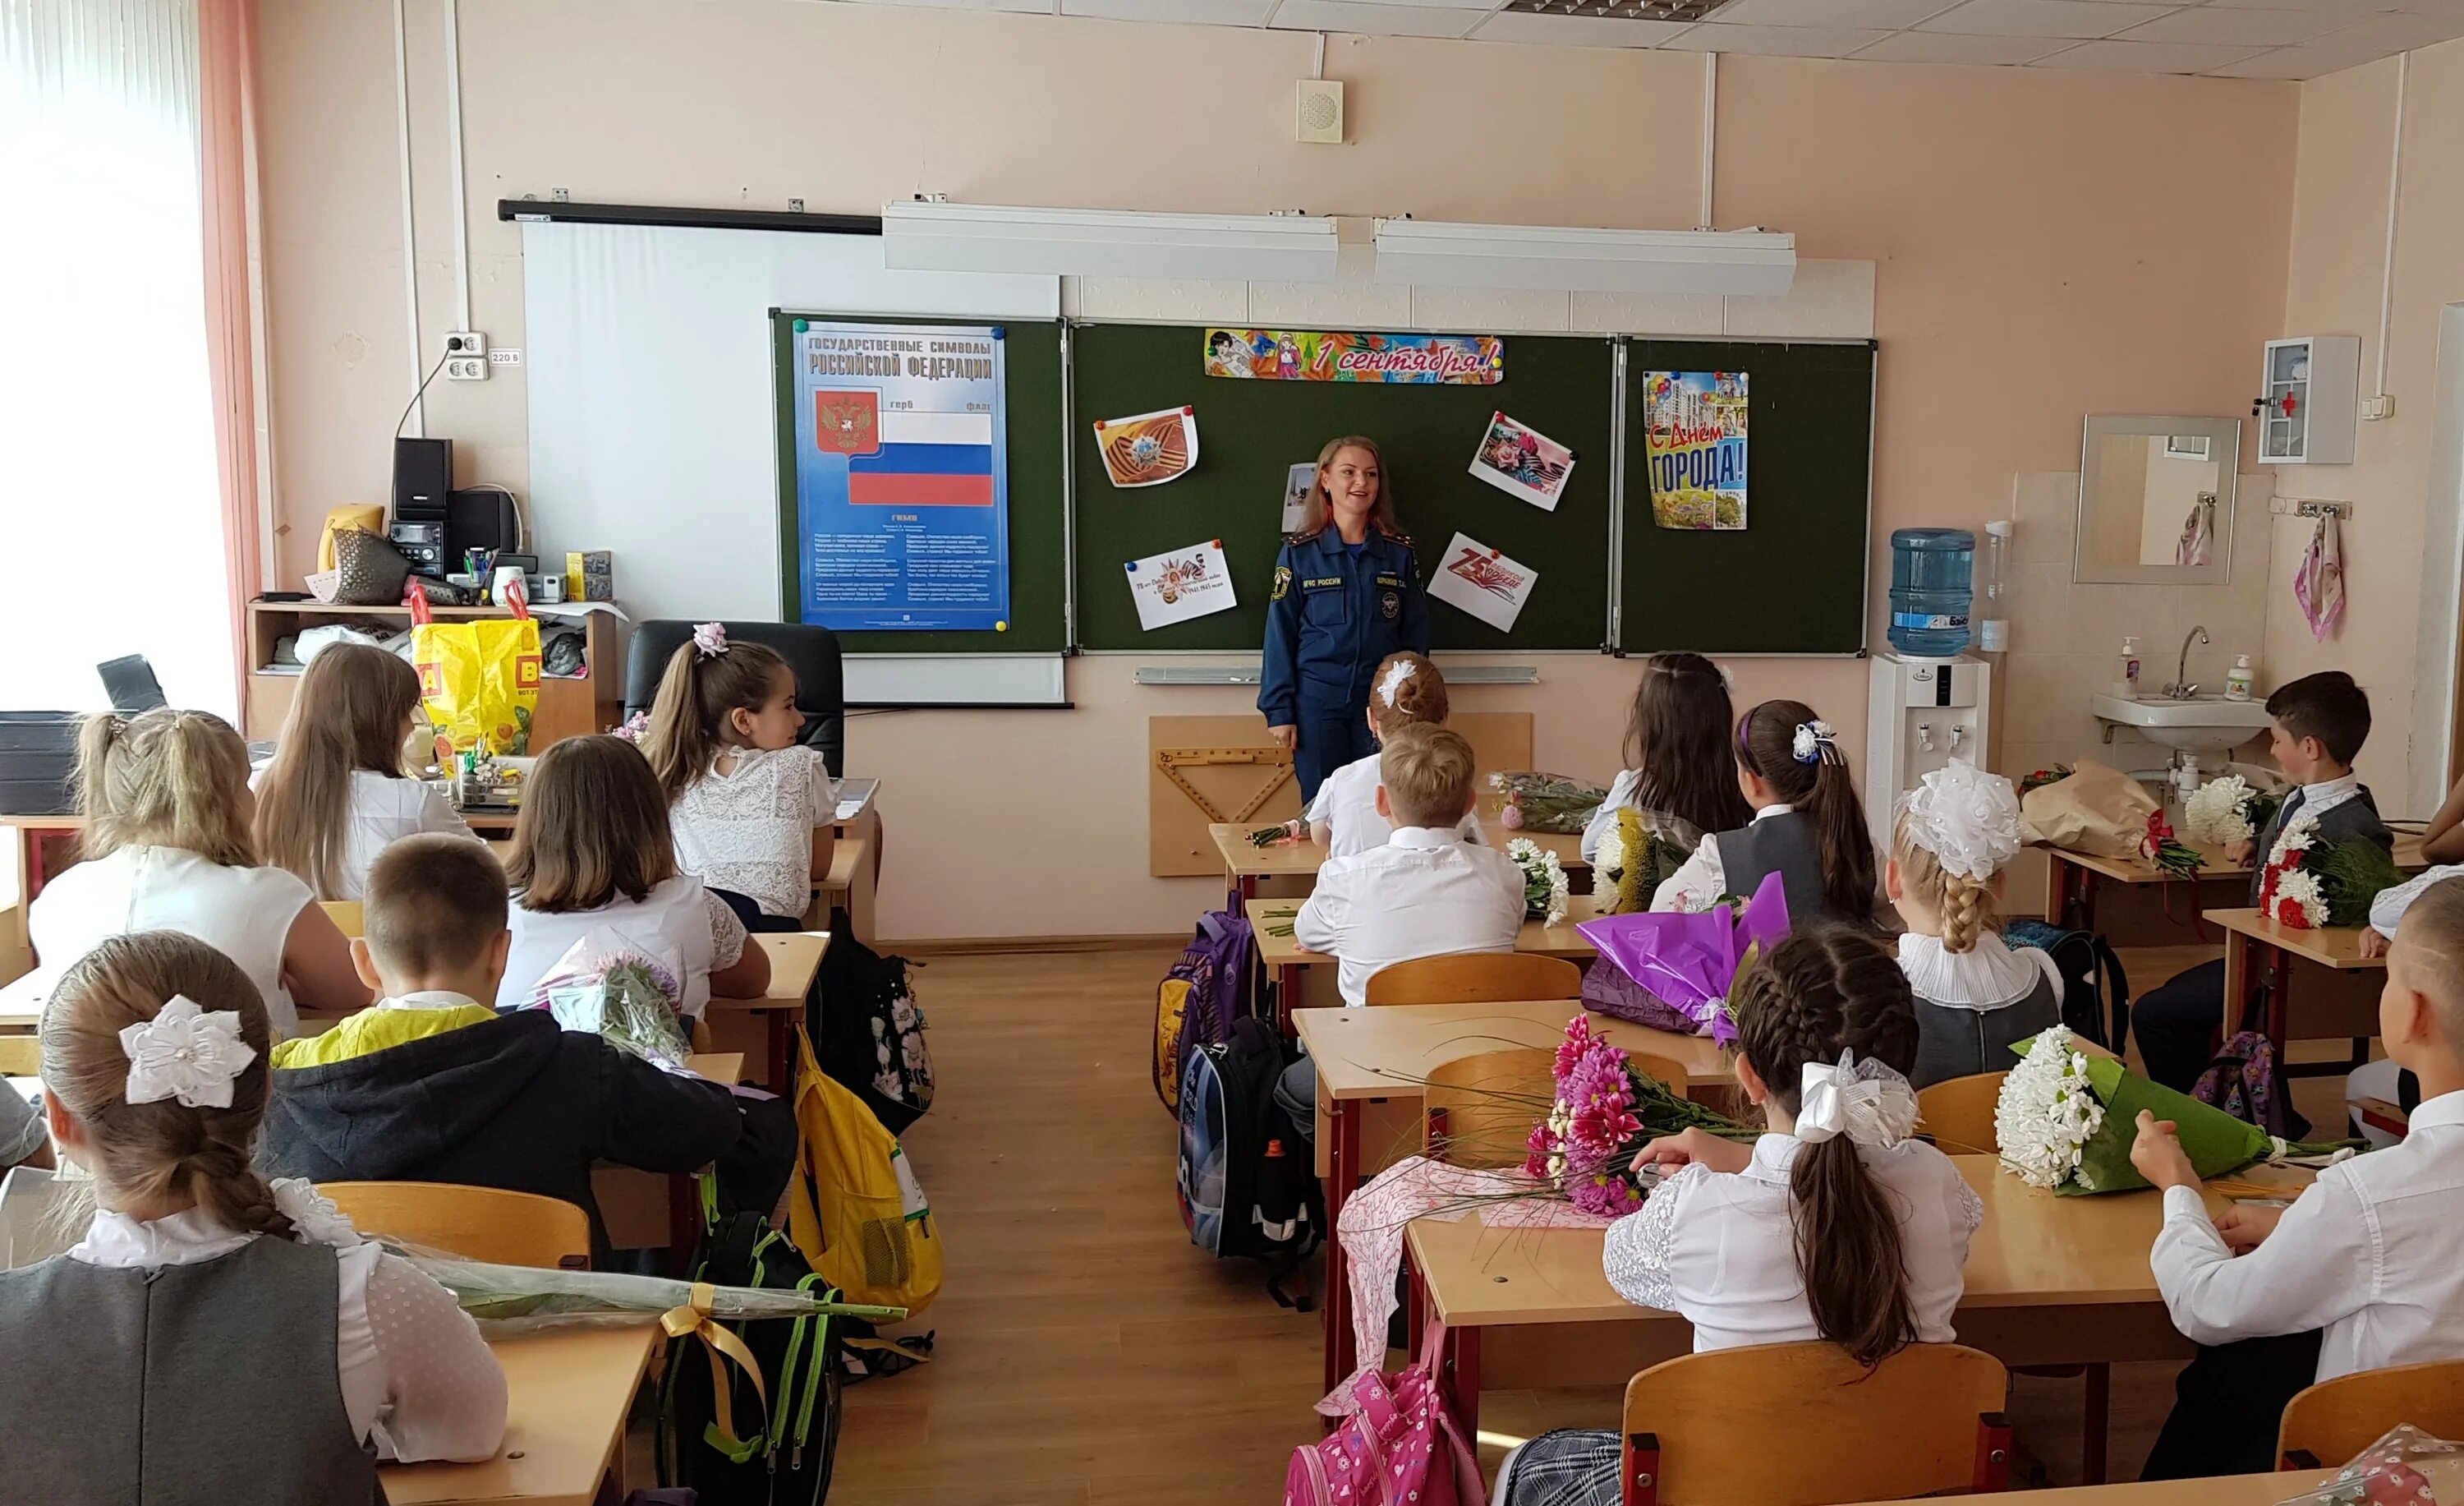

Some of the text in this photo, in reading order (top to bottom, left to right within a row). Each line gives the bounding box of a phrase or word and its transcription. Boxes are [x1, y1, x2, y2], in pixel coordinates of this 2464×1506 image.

[808, 338, 991, 354] ГОСУДАРСТВЕННЫЕ СИМВОЛЫ
[810, 352, 992, 381] РОССИЙСКОЙ ФЕДЕРАЦИИ
[1314, 341, 1500, 380] 1 сентября!
[890, 401, 913, 409] герб
[1649, 421, 1723, 449] С Днём
[1651, 442, 1745, 493] ГОРОДА!
[1447, 547, 1493, 579] 75
[1487, 568, 1521, 589] ПОБЕДЕ
